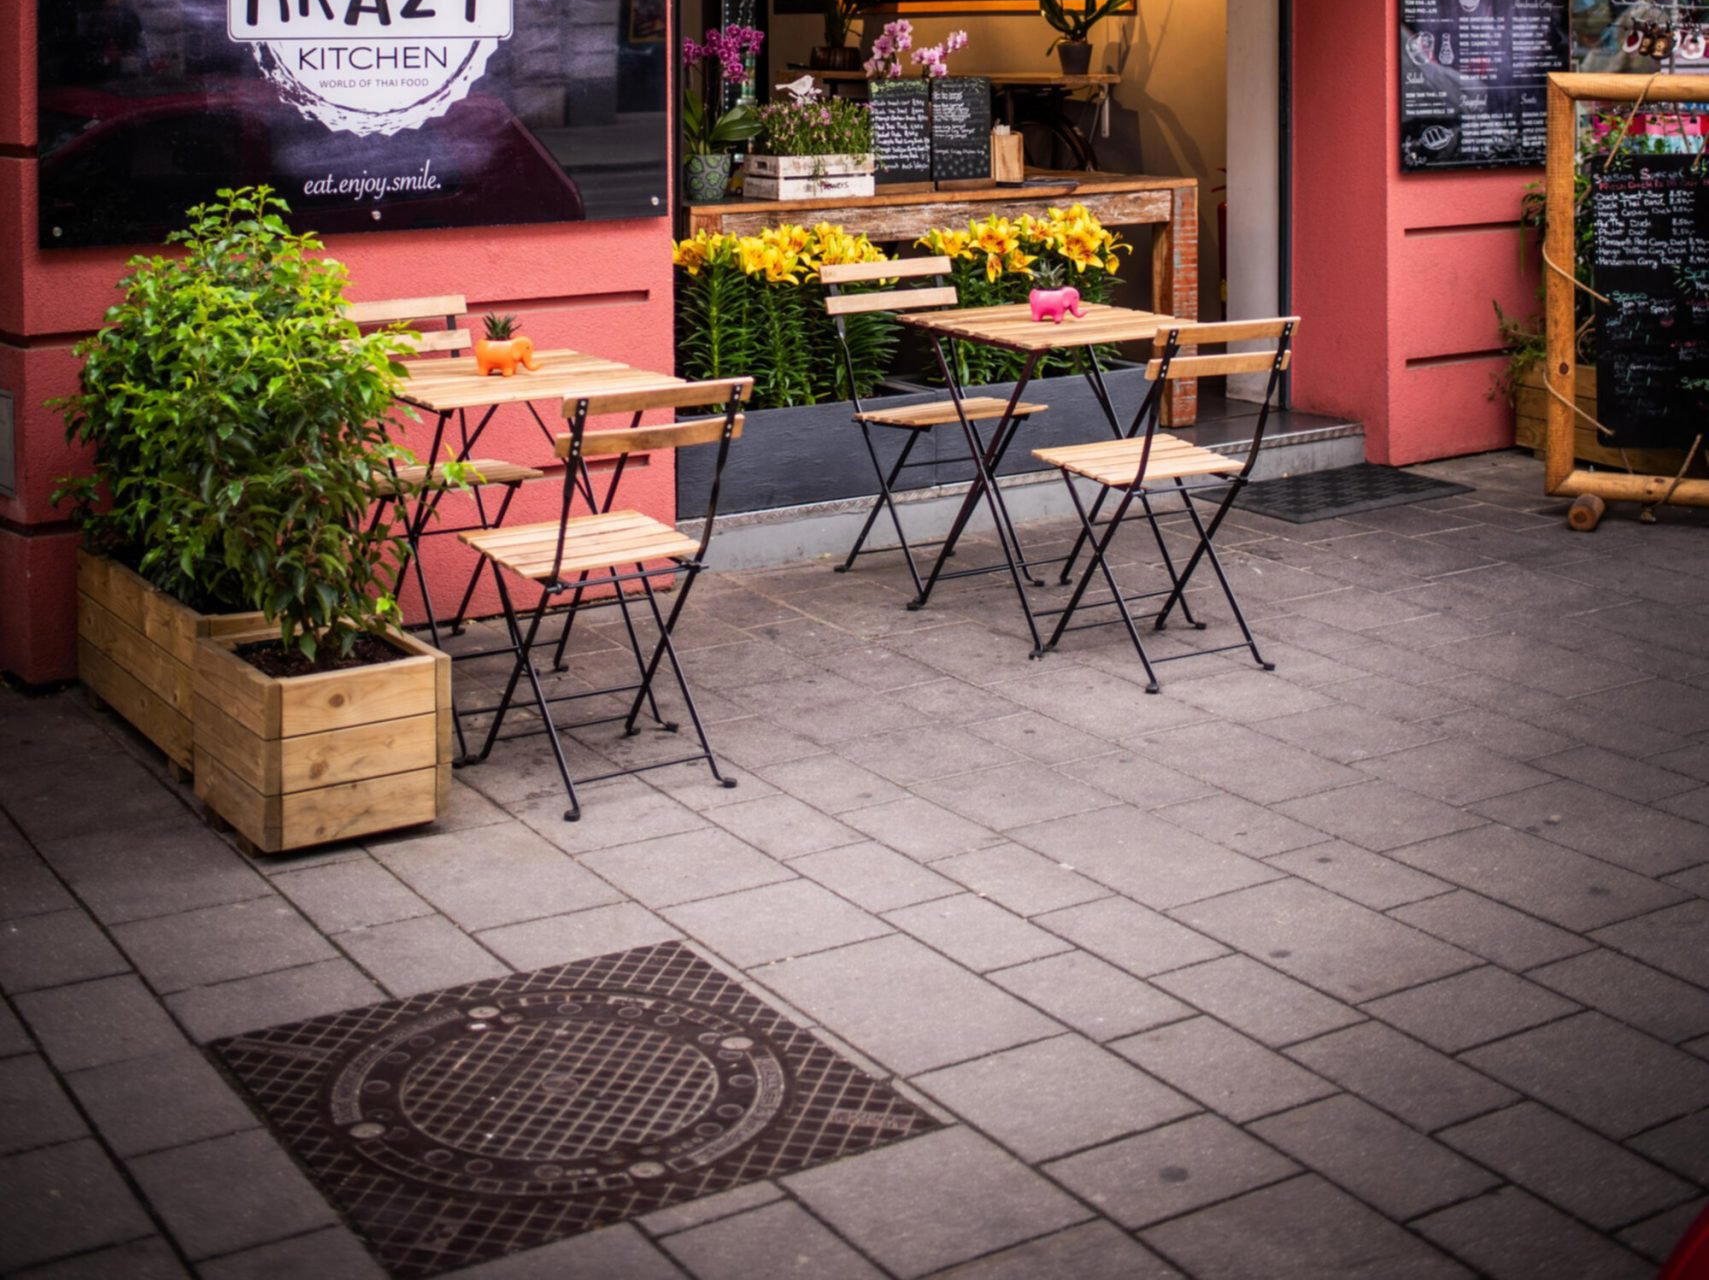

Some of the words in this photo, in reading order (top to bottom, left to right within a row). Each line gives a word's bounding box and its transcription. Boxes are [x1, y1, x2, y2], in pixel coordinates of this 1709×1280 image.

[299, 46, 448, 71] KITCHEN
[319, 78, 356, 89] WORLD
[358, 78, 372, 88] OF
[375, 78, 398, 88] THAI
[400, 77, 430, 88] FOOD
